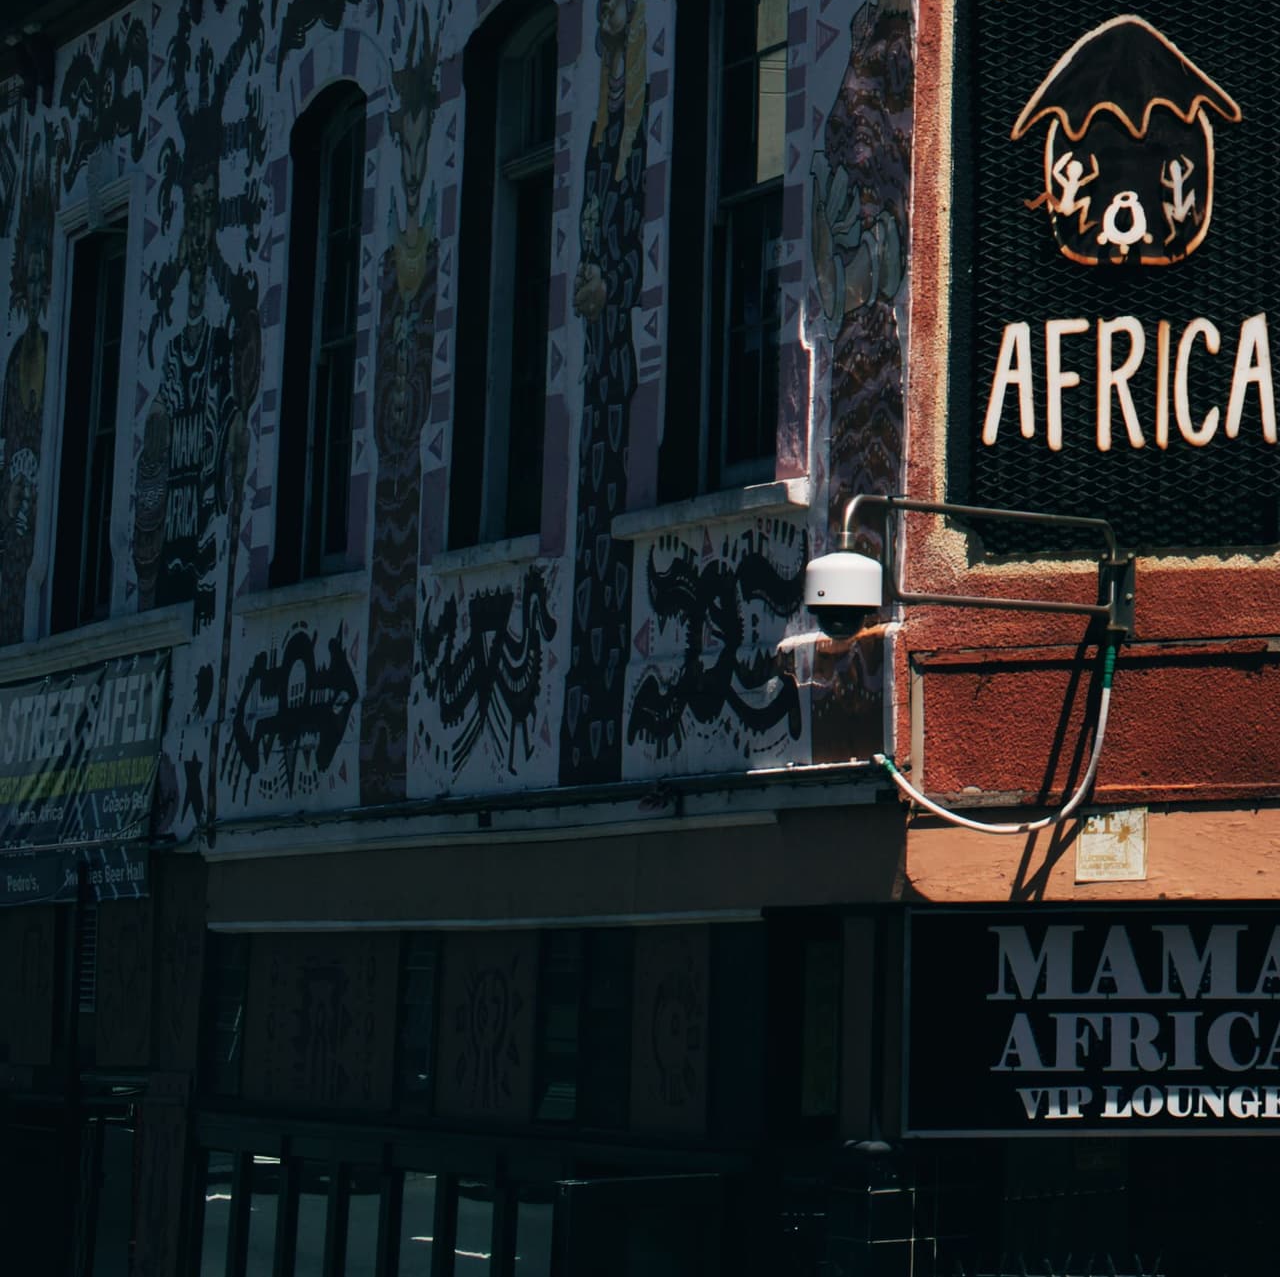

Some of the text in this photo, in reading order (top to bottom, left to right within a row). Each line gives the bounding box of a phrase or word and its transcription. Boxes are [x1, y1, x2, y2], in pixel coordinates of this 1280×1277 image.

[981, 311, 1278, 452] AFRICA
[4, 667, 167, 766] STREET SAFELY
[1016, 1086, 1092, 1120] VIP
